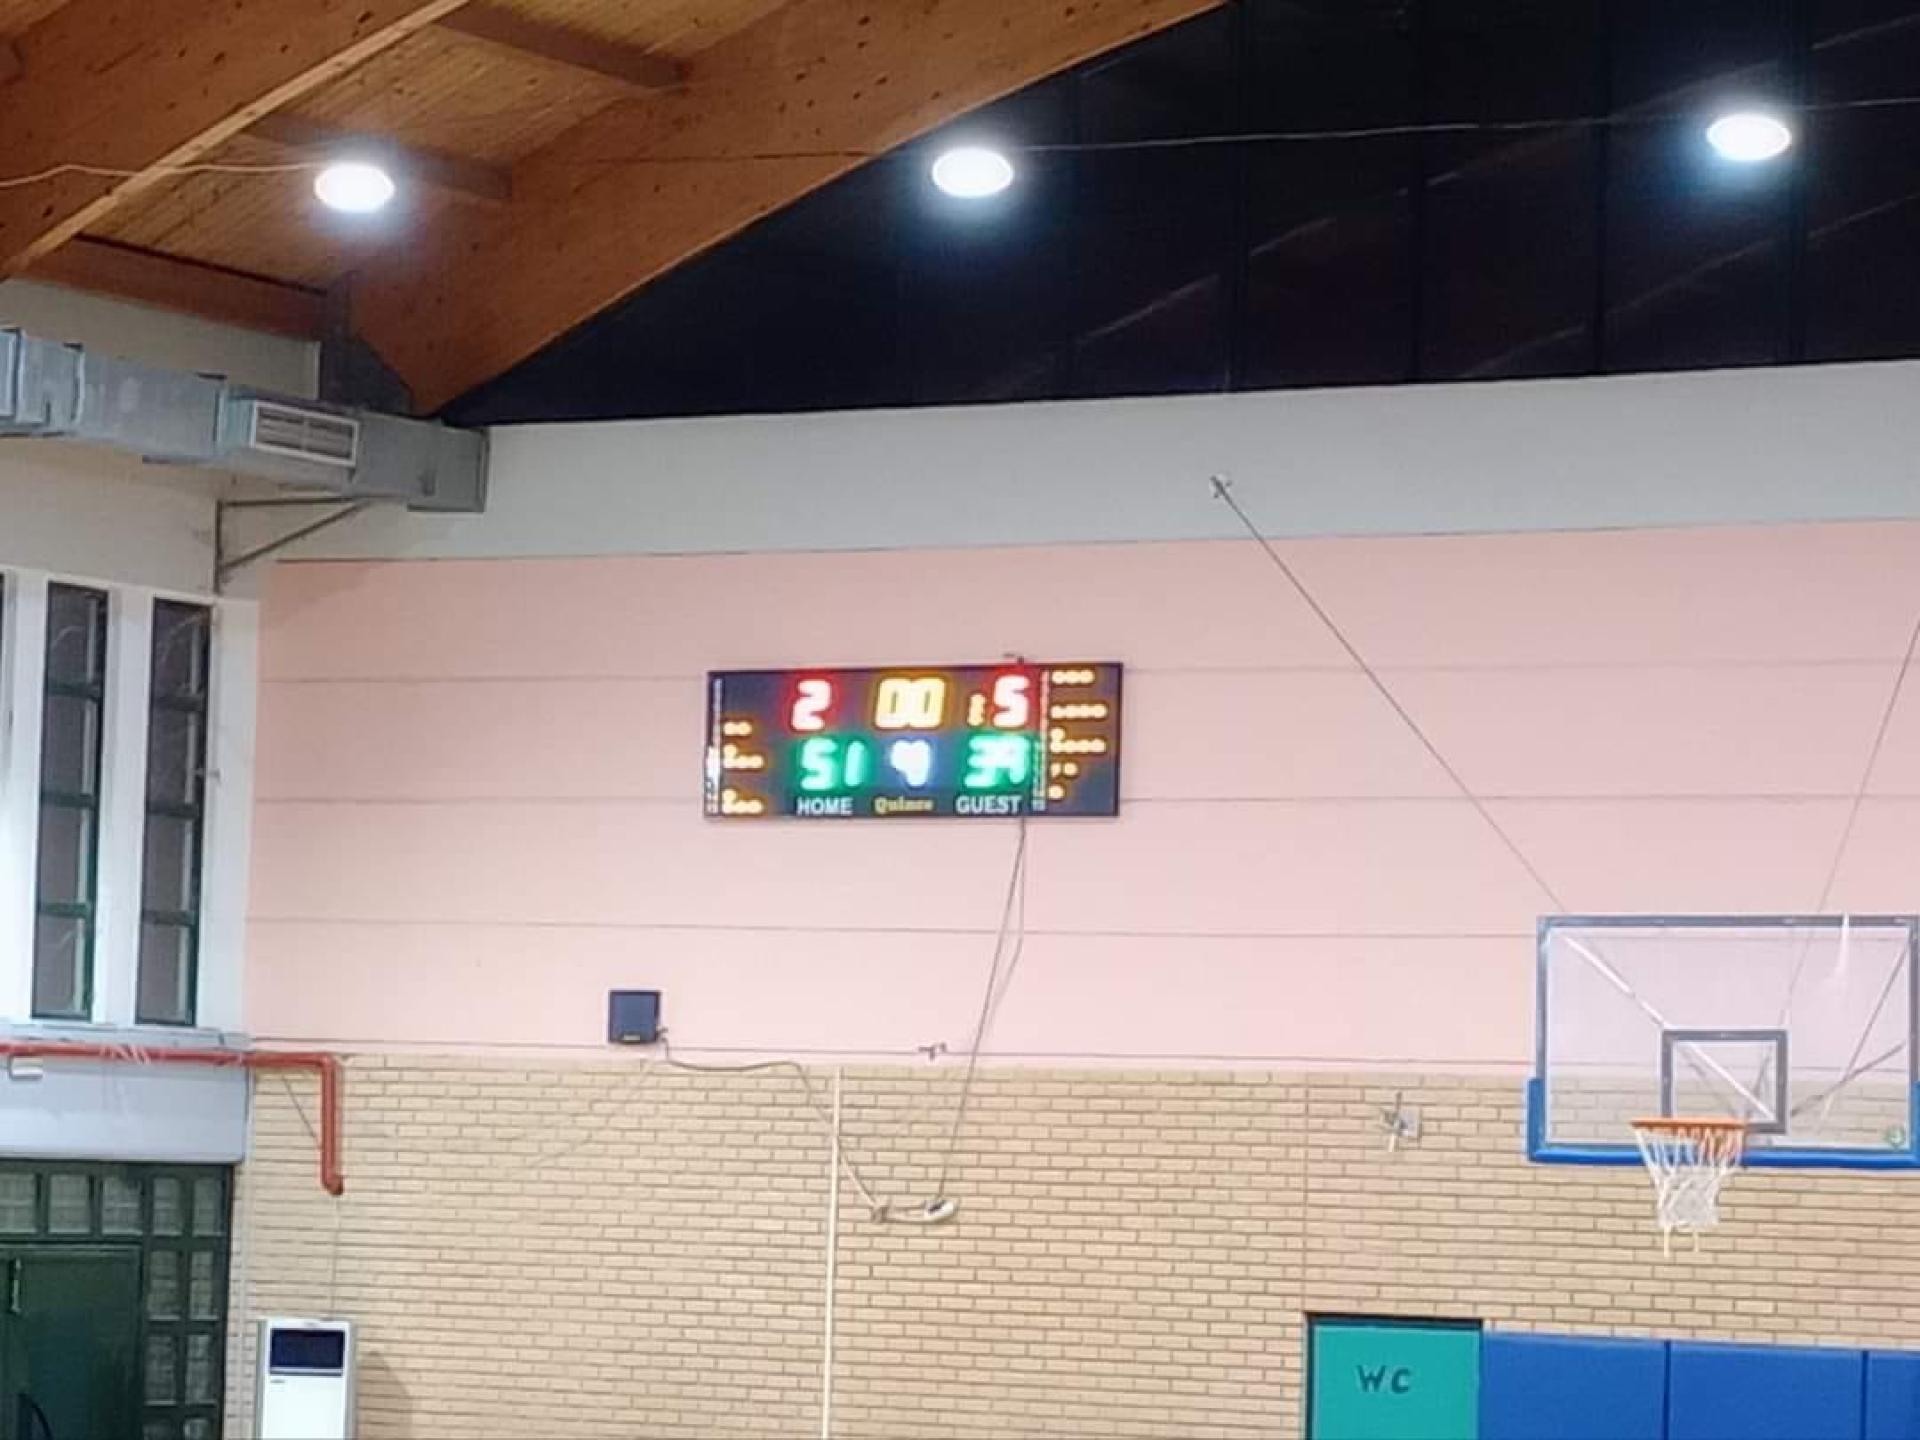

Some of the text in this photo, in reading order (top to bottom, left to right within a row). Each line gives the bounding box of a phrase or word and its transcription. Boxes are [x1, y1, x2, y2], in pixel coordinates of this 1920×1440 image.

[790, 679, 833, 731] 2
[875, 677, 945, 729] 00
[800, 736, 866, 790] 51
[796, 796, 854, 816] HOME
[955, 795, 1022, 815] GUEST
[1356, 1364, 1412, 1394] WC
